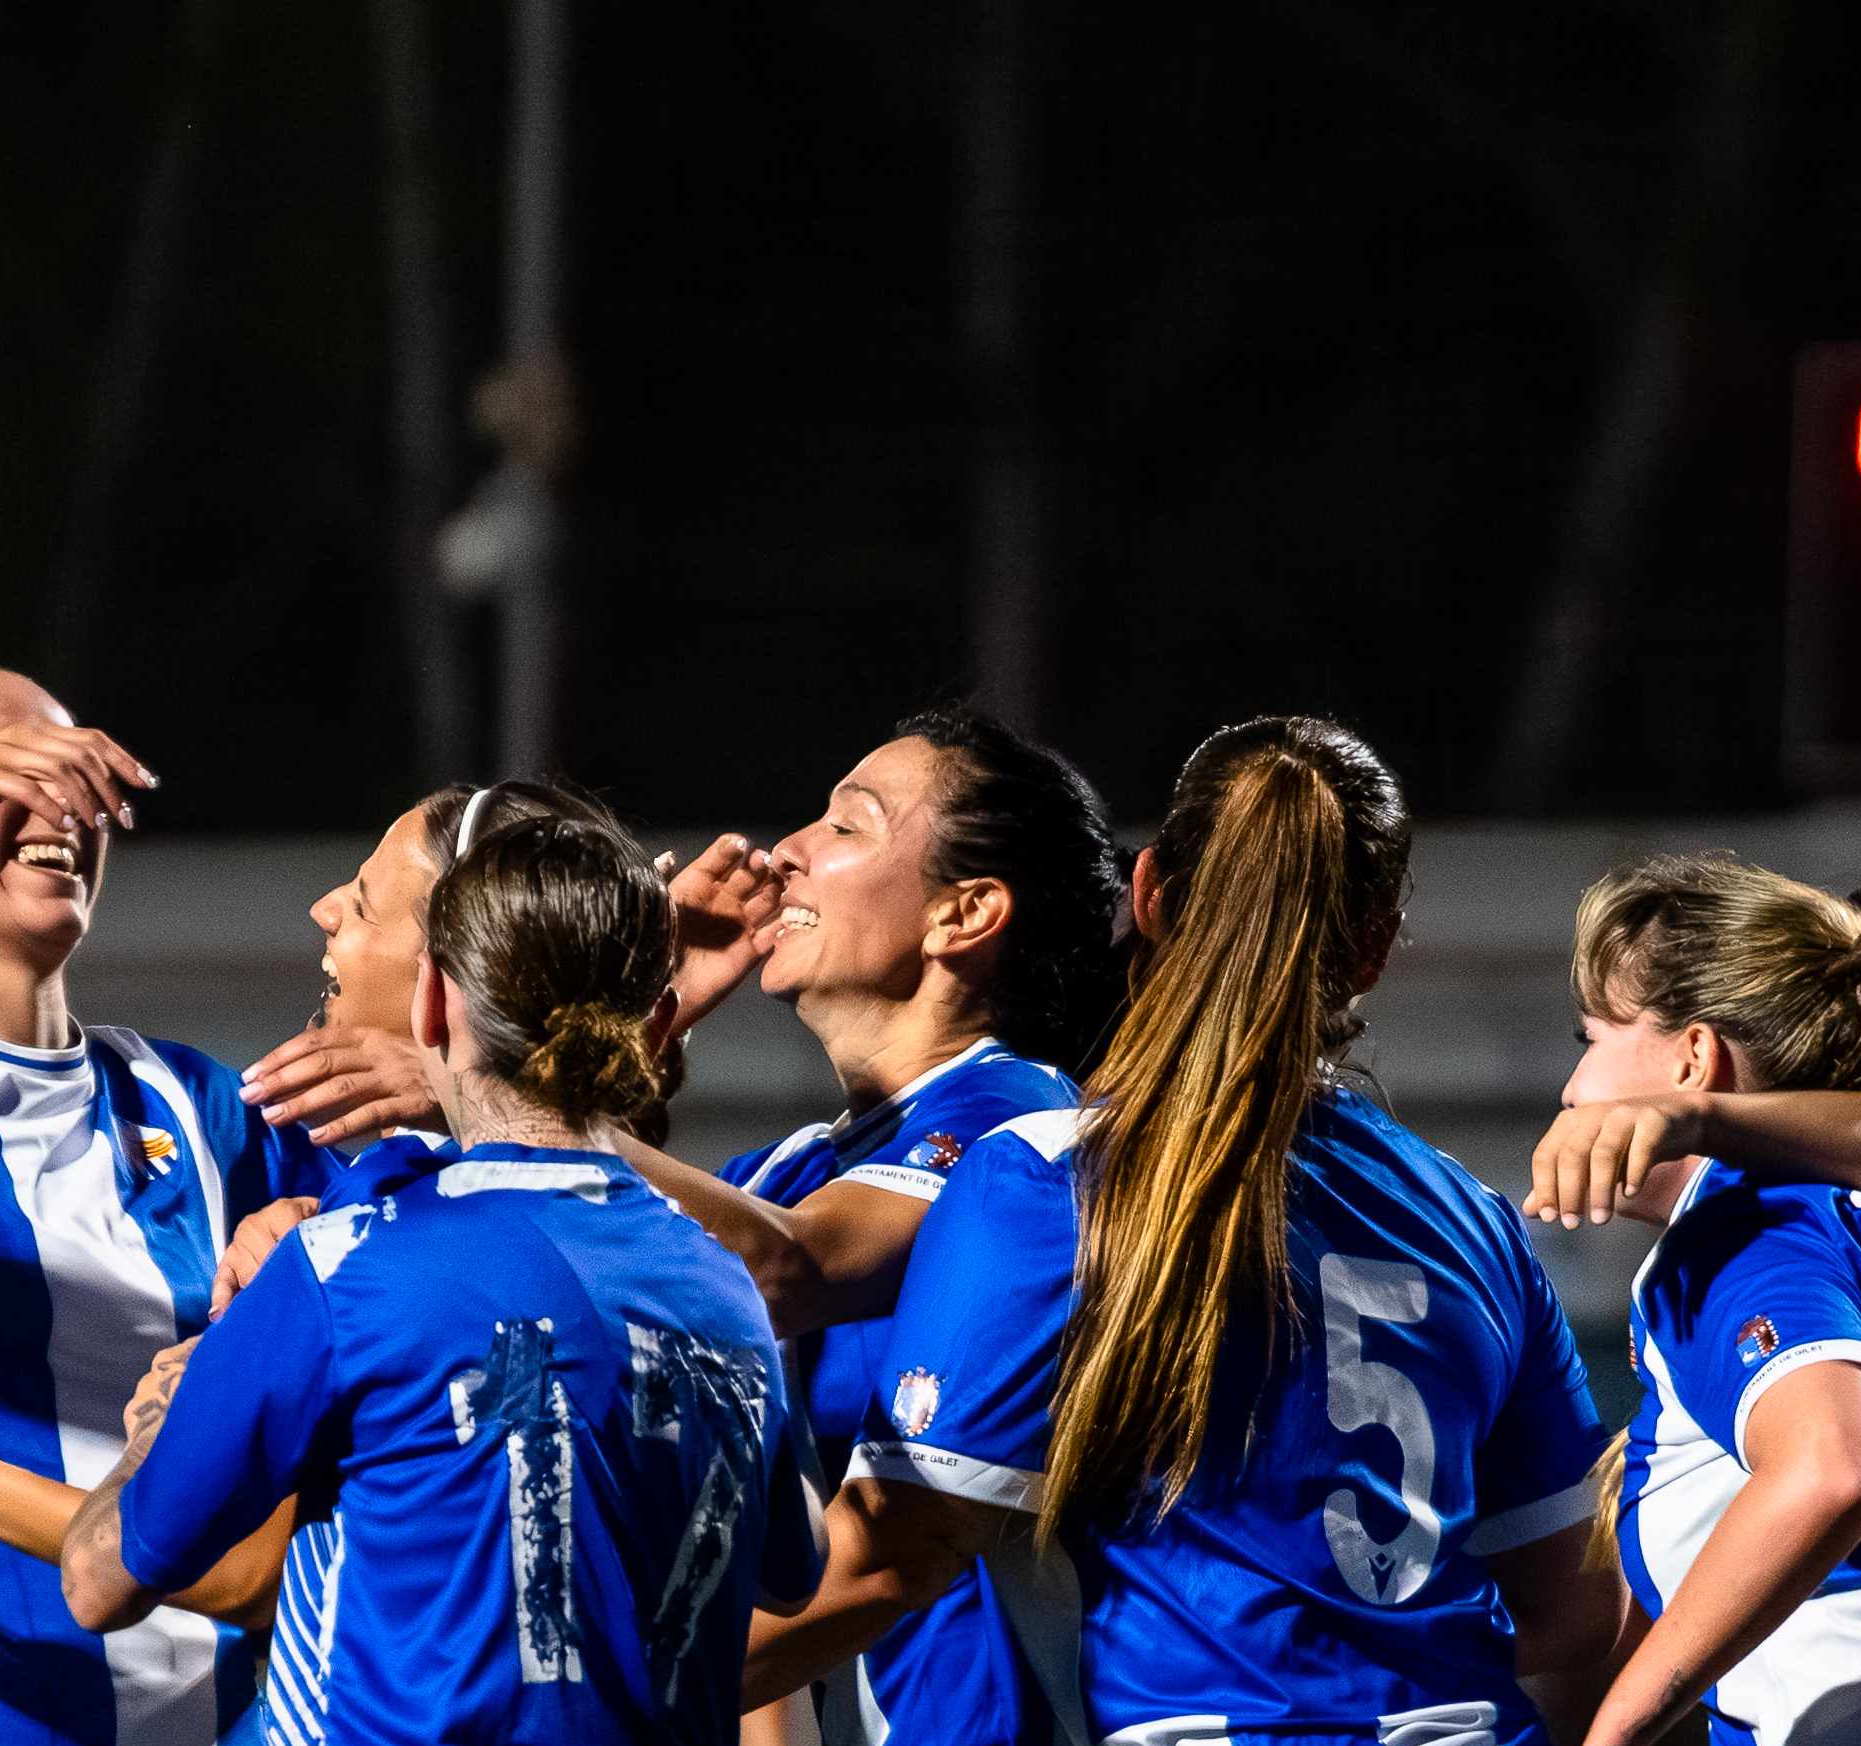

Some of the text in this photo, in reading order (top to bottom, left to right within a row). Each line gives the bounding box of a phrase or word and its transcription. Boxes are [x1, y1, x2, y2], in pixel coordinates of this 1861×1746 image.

[916, 1176, 930, 1186] DE
[448, 1316, 770, 1708] 17
[913, 1451, 959, 1467] DE GILET
[1319, 1252, 1441, 1604] 5
